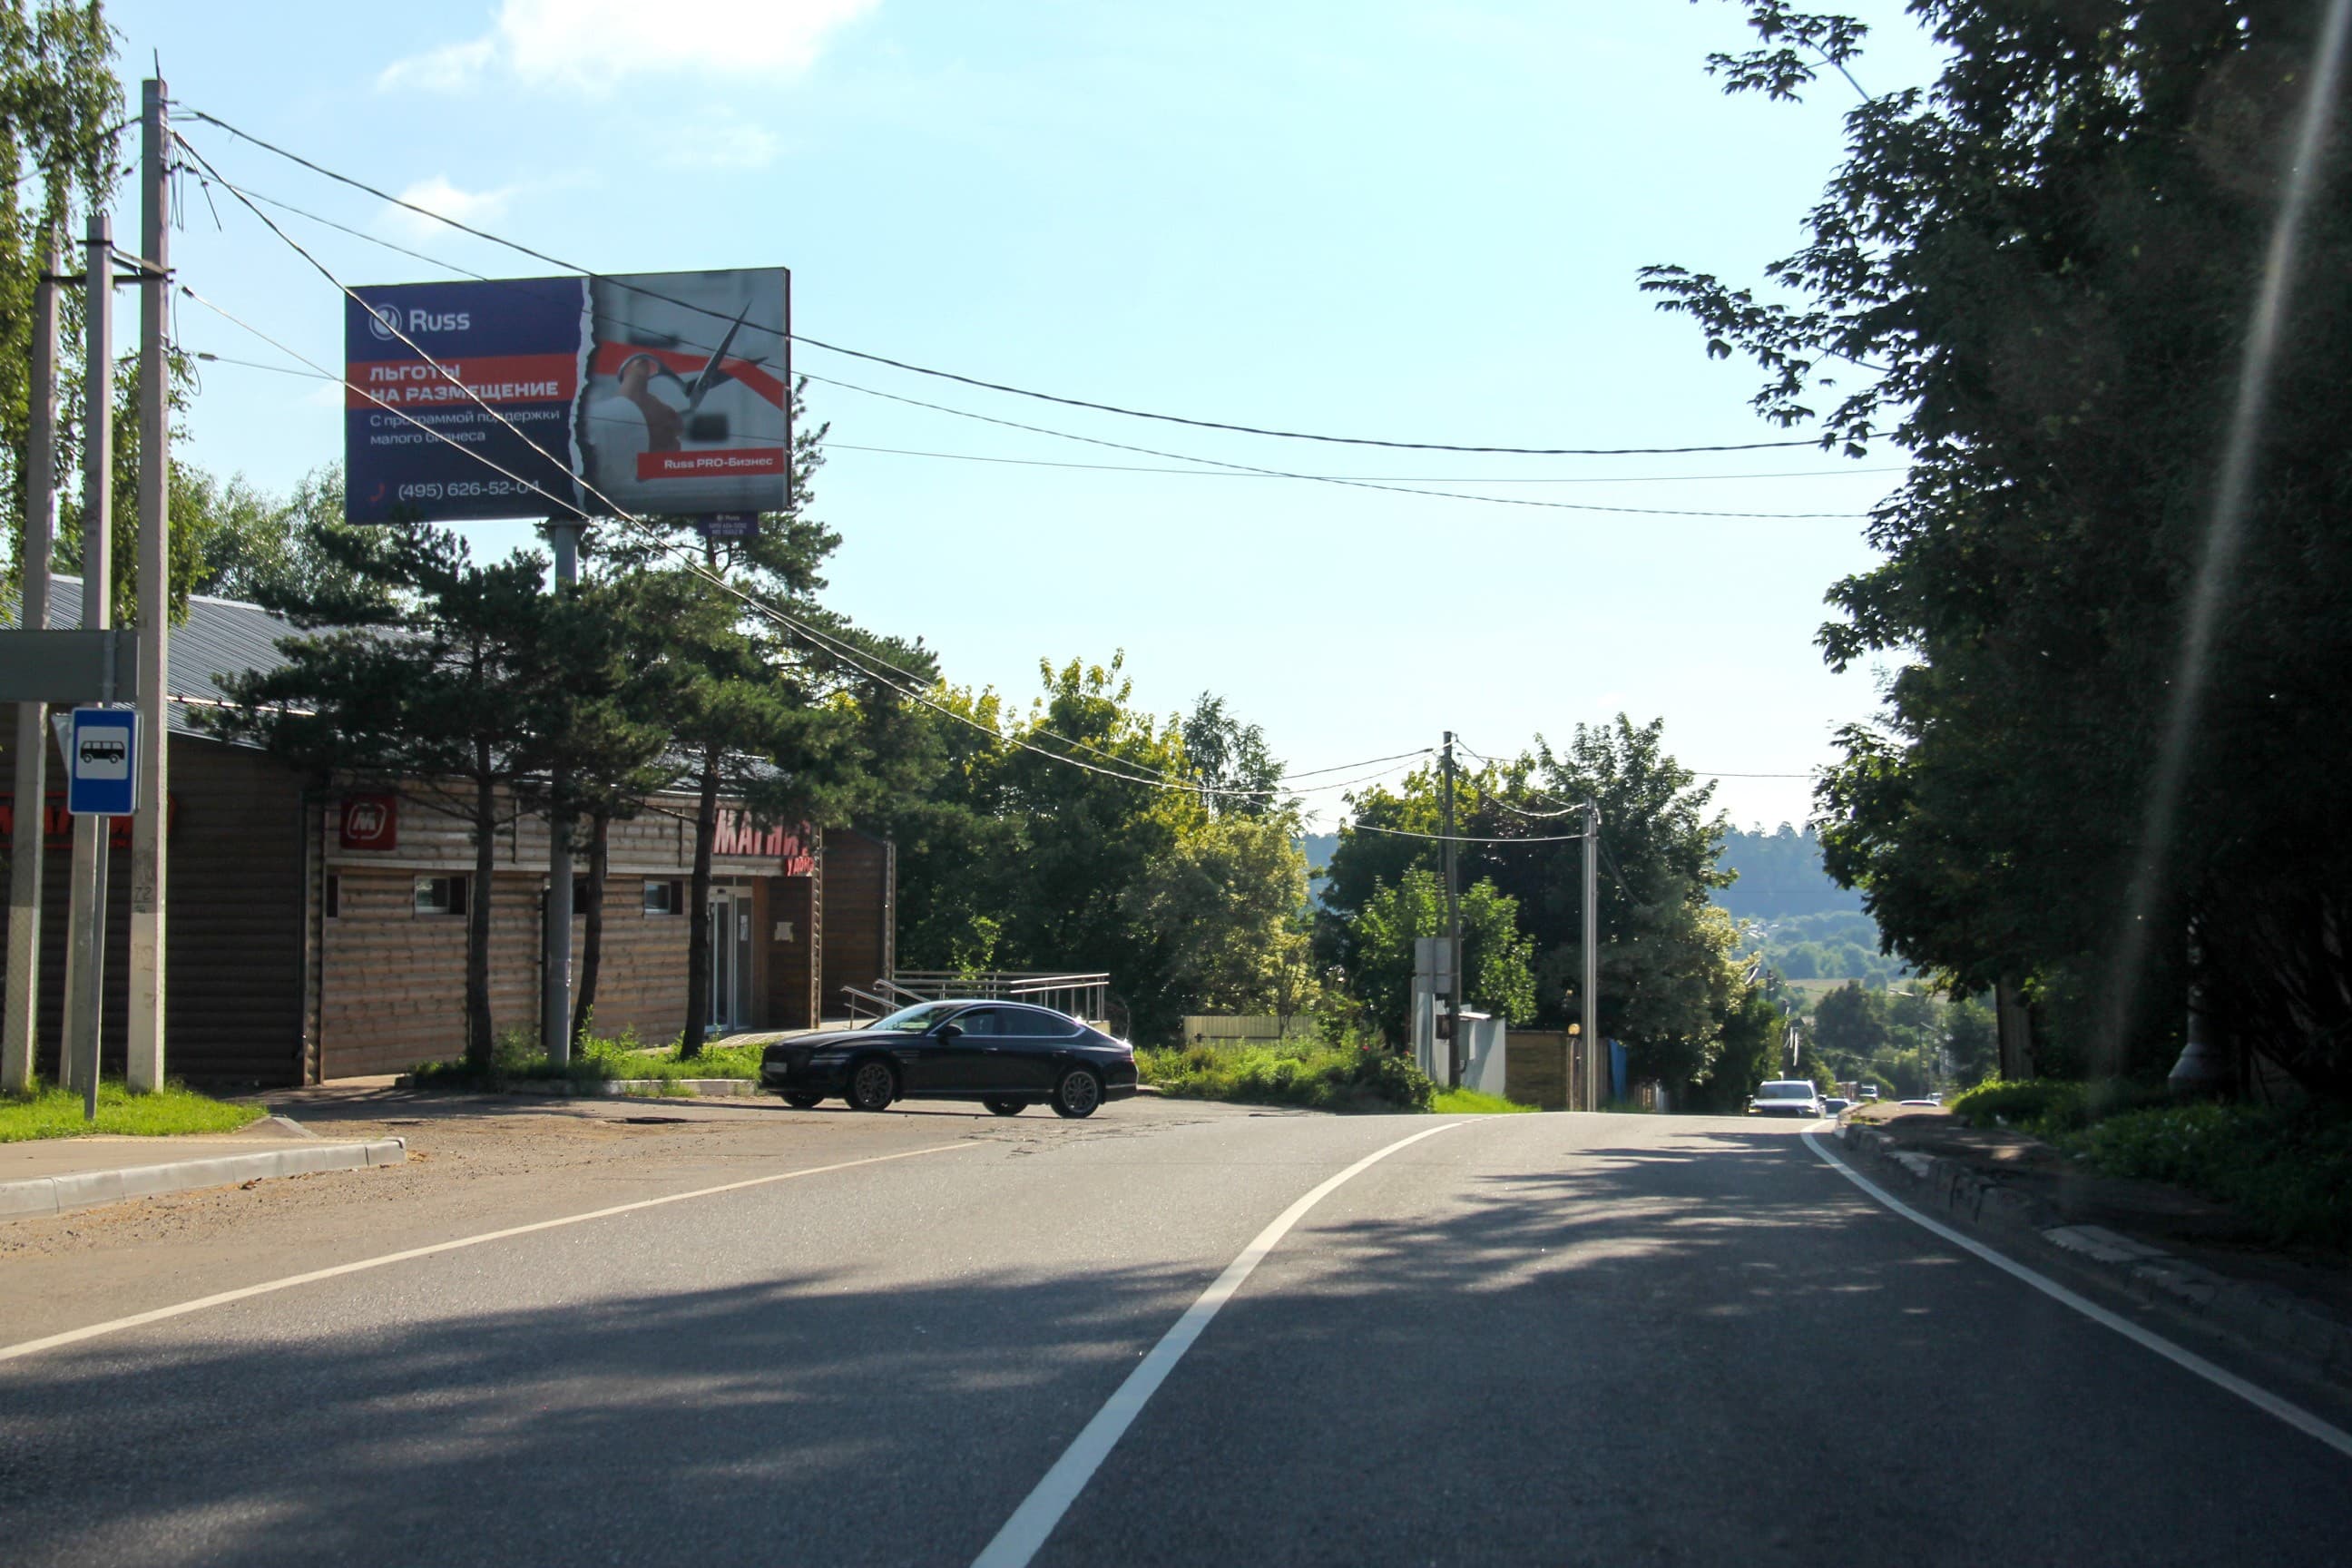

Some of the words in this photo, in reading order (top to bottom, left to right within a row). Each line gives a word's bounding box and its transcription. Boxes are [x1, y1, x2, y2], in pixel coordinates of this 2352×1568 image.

[409, 309, 470, 332] Russ
[369, 365, 460, 381] ЛЬГОТЫ
[370, 390, 399, 404] НА
[407, 382, 558, 402] РАЗМЕЩЕНИЕ
[370, 415, 381, 427] С
[370, 433, 422, 446] малого
[664, 459, 694, 469] Russ
[398, 483, 443, 500] (495)
